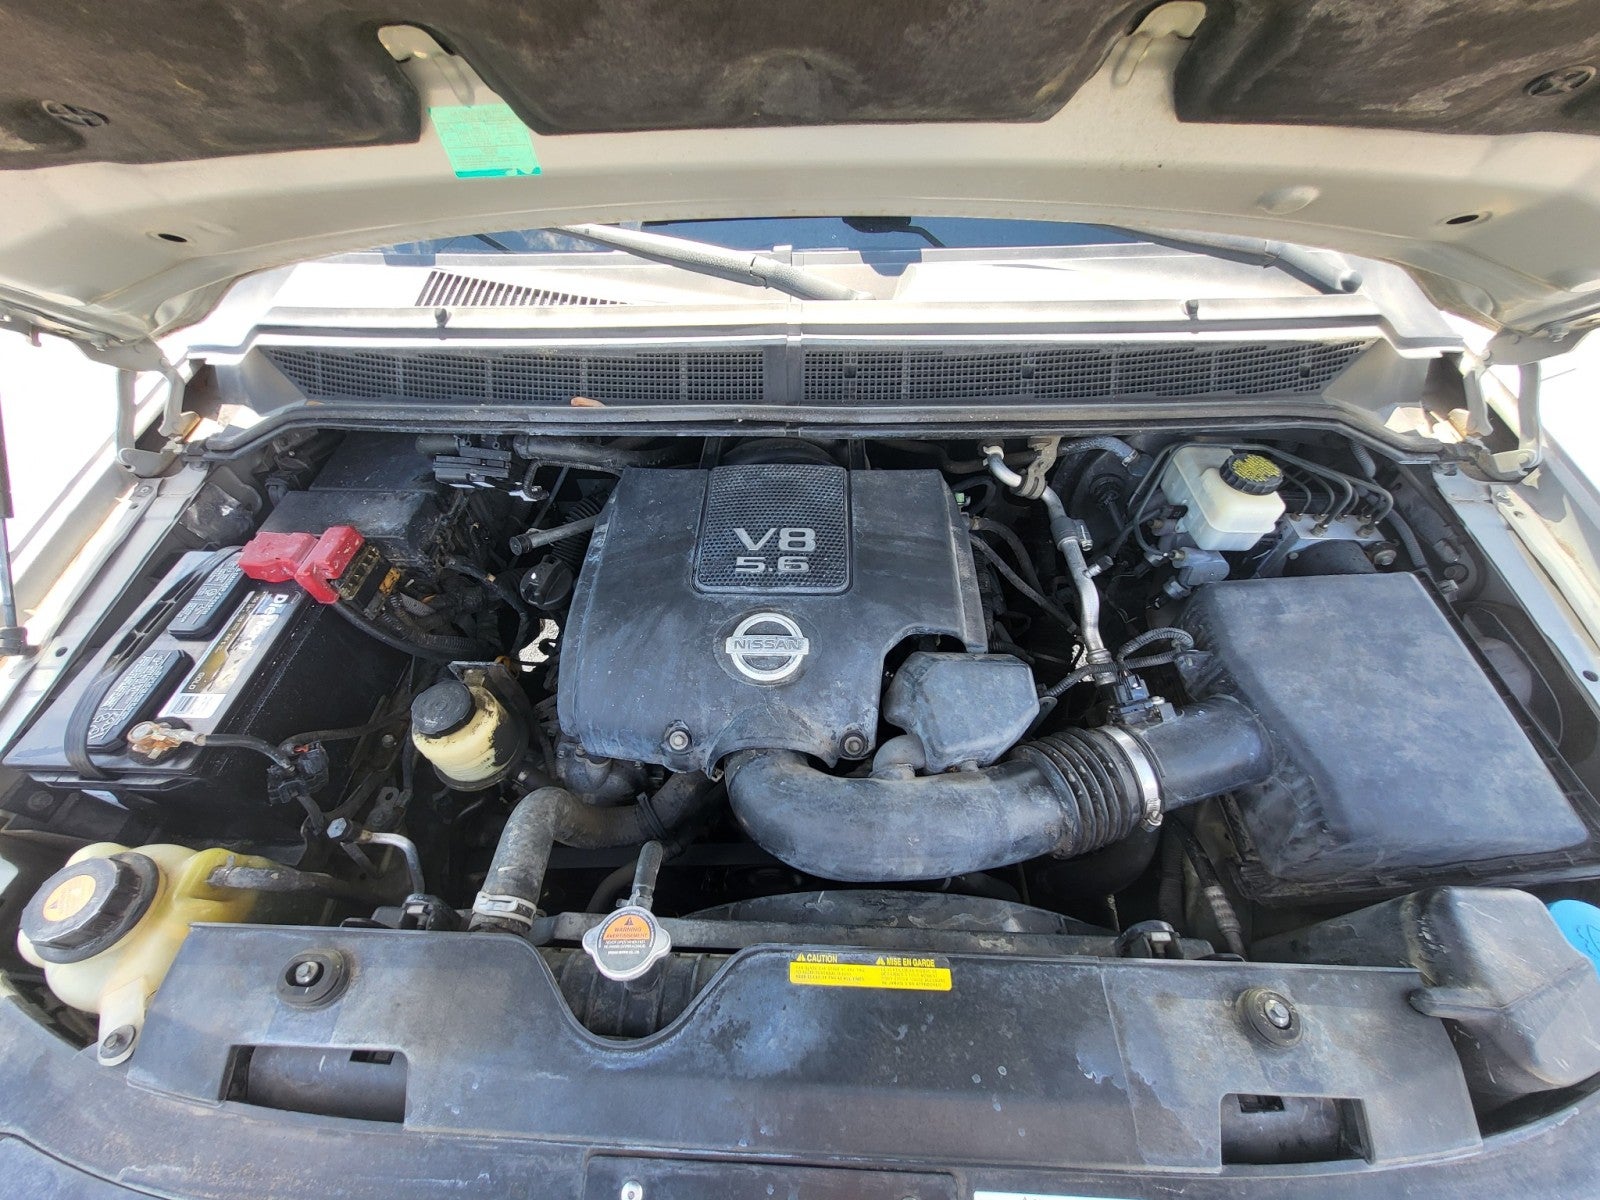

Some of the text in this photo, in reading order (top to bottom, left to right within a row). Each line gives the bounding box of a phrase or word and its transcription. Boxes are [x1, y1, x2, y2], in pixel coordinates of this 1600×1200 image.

[733, 528, 816, 551] V8
[735, 556, 810, 573] 5.6
[734, 639, 801, 650] NISSAN
[807, 953, 838, 963] CAUTION
[887, 957, 935, 968] MISE EN GARDE
